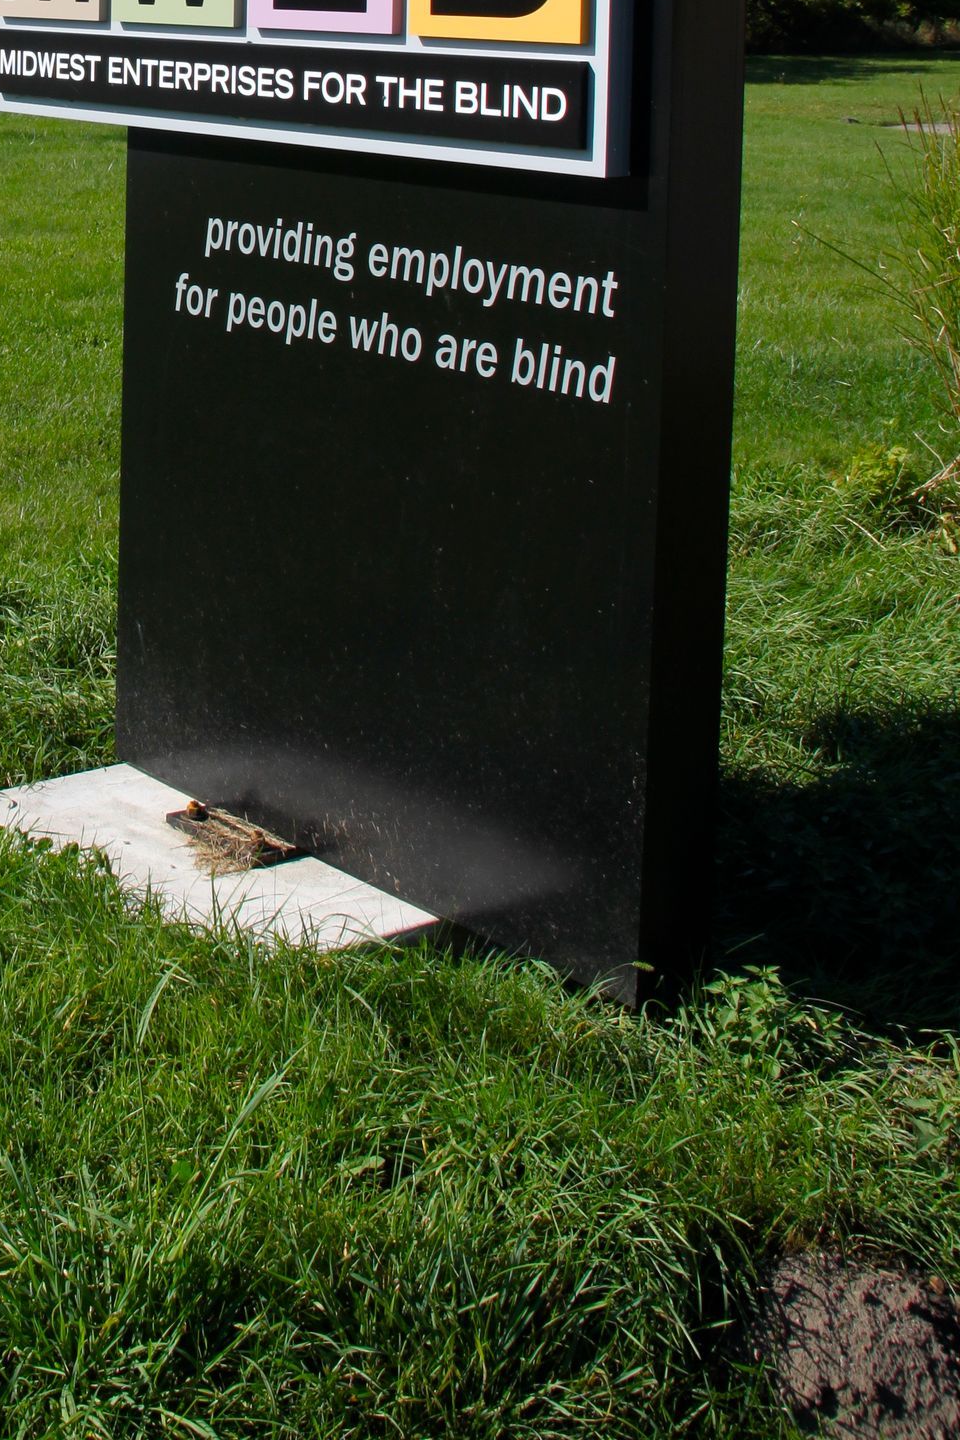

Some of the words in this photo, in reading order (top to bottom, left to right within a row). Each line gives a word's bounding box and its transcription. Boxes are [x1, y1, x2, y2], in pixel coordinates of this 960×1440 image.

[0, 48, 102, 82] MIDWEST
[107, 56, 294, 100] ENTERPRISES
[303, 70, 367, 106] FOR
[375, 75, 445, 112] THE
[454, 80, 567, 122] BLIND
[204, 215, 357, 282] providing
[368, 243, 619, 318] employment
[174, 272, 219, 318] for
[226, 292, 337, 345] people
[349, 311, 422, 362] who
[435, 334, 498, 378] are
[511, 337, 616, 404] blind
